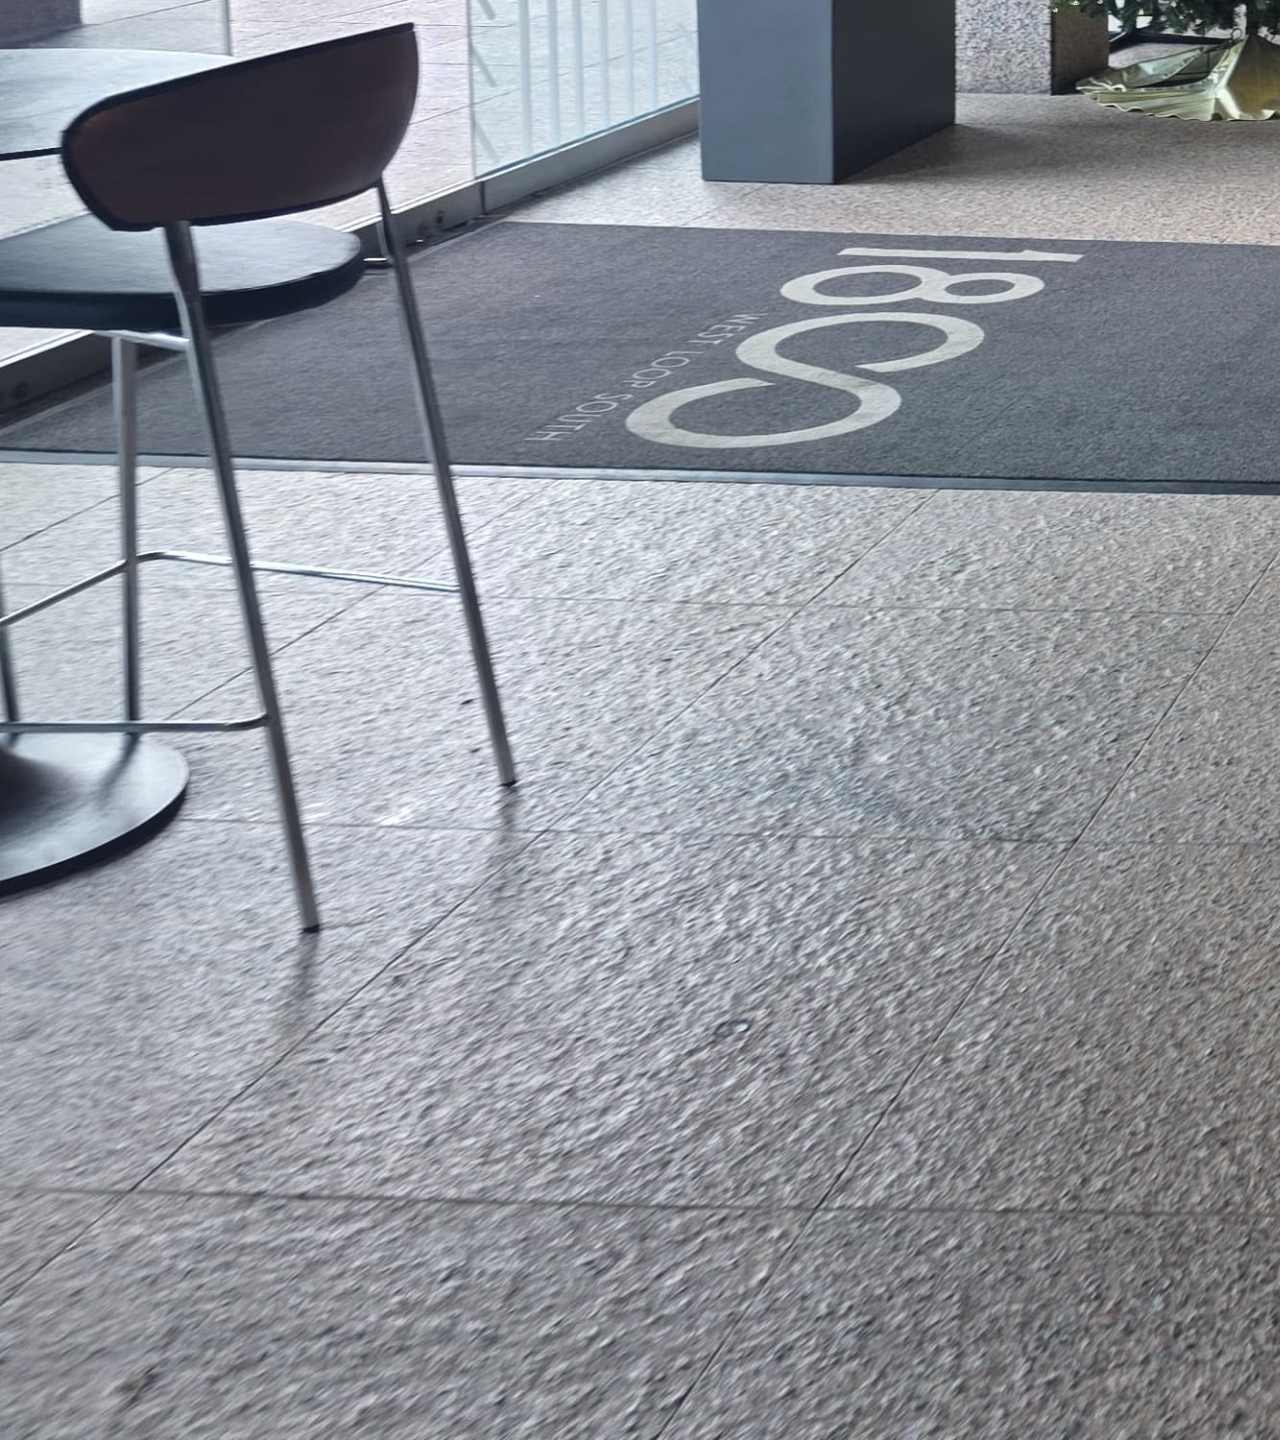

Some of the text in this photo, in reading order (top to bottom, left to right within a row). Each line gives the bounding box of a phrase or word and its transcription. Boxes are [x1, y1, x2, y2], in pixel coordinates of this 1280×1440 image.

[525, 313, 768, 441] WEST LOOP SOUTH
